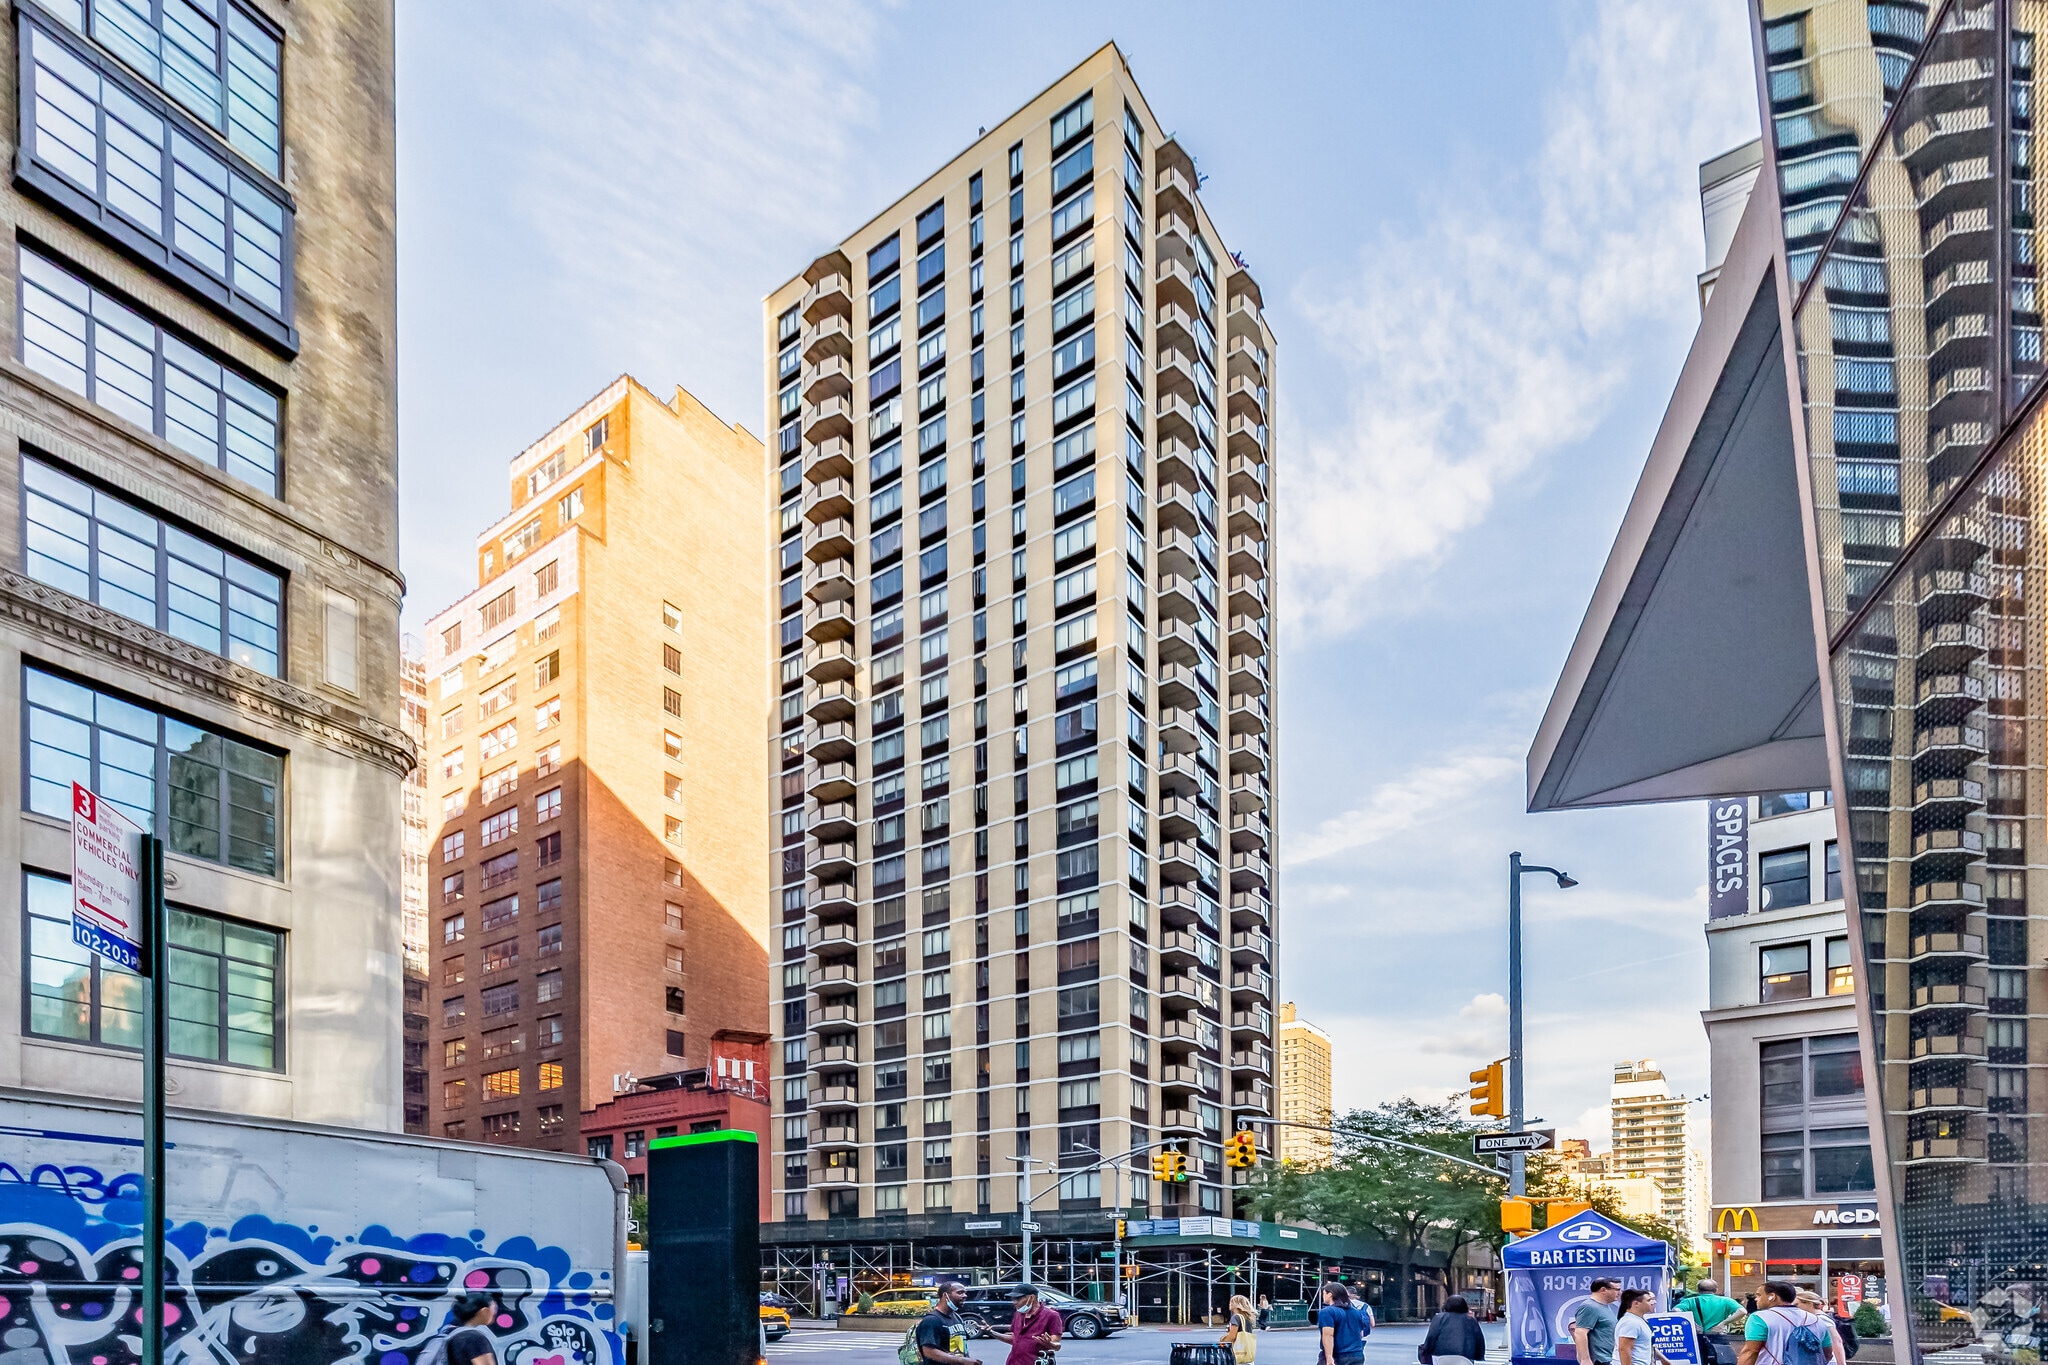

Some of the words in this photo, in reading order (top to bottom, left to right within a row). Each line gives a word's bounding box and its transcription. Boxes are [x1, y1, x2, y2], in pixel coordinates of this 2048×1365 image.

[78, 789, 92, 818] 3
[77, 821, 132, 865] COMMERCIAL
[1715, 804, 1743, 899] SPACES.
[77, 835, 117, 869] VEHICLES
[119, 861, 140, 881] ONLY
[77, 867, 105, 889] Monday
[110, 886, 131, 906] Friday
[1485, 1138, 1508, 1148] ONE
[1518, 1136, 1543, 1145] WAY
[1812, 1208, 1880, 1224] McD
[1530, 1250, 1564, 1265] BAR
[1566, 1248, 1636, 1263] TESTING
[546, 1323, 576, 1337] Solo
[1652, 1324, 1684, 1336] PCR
